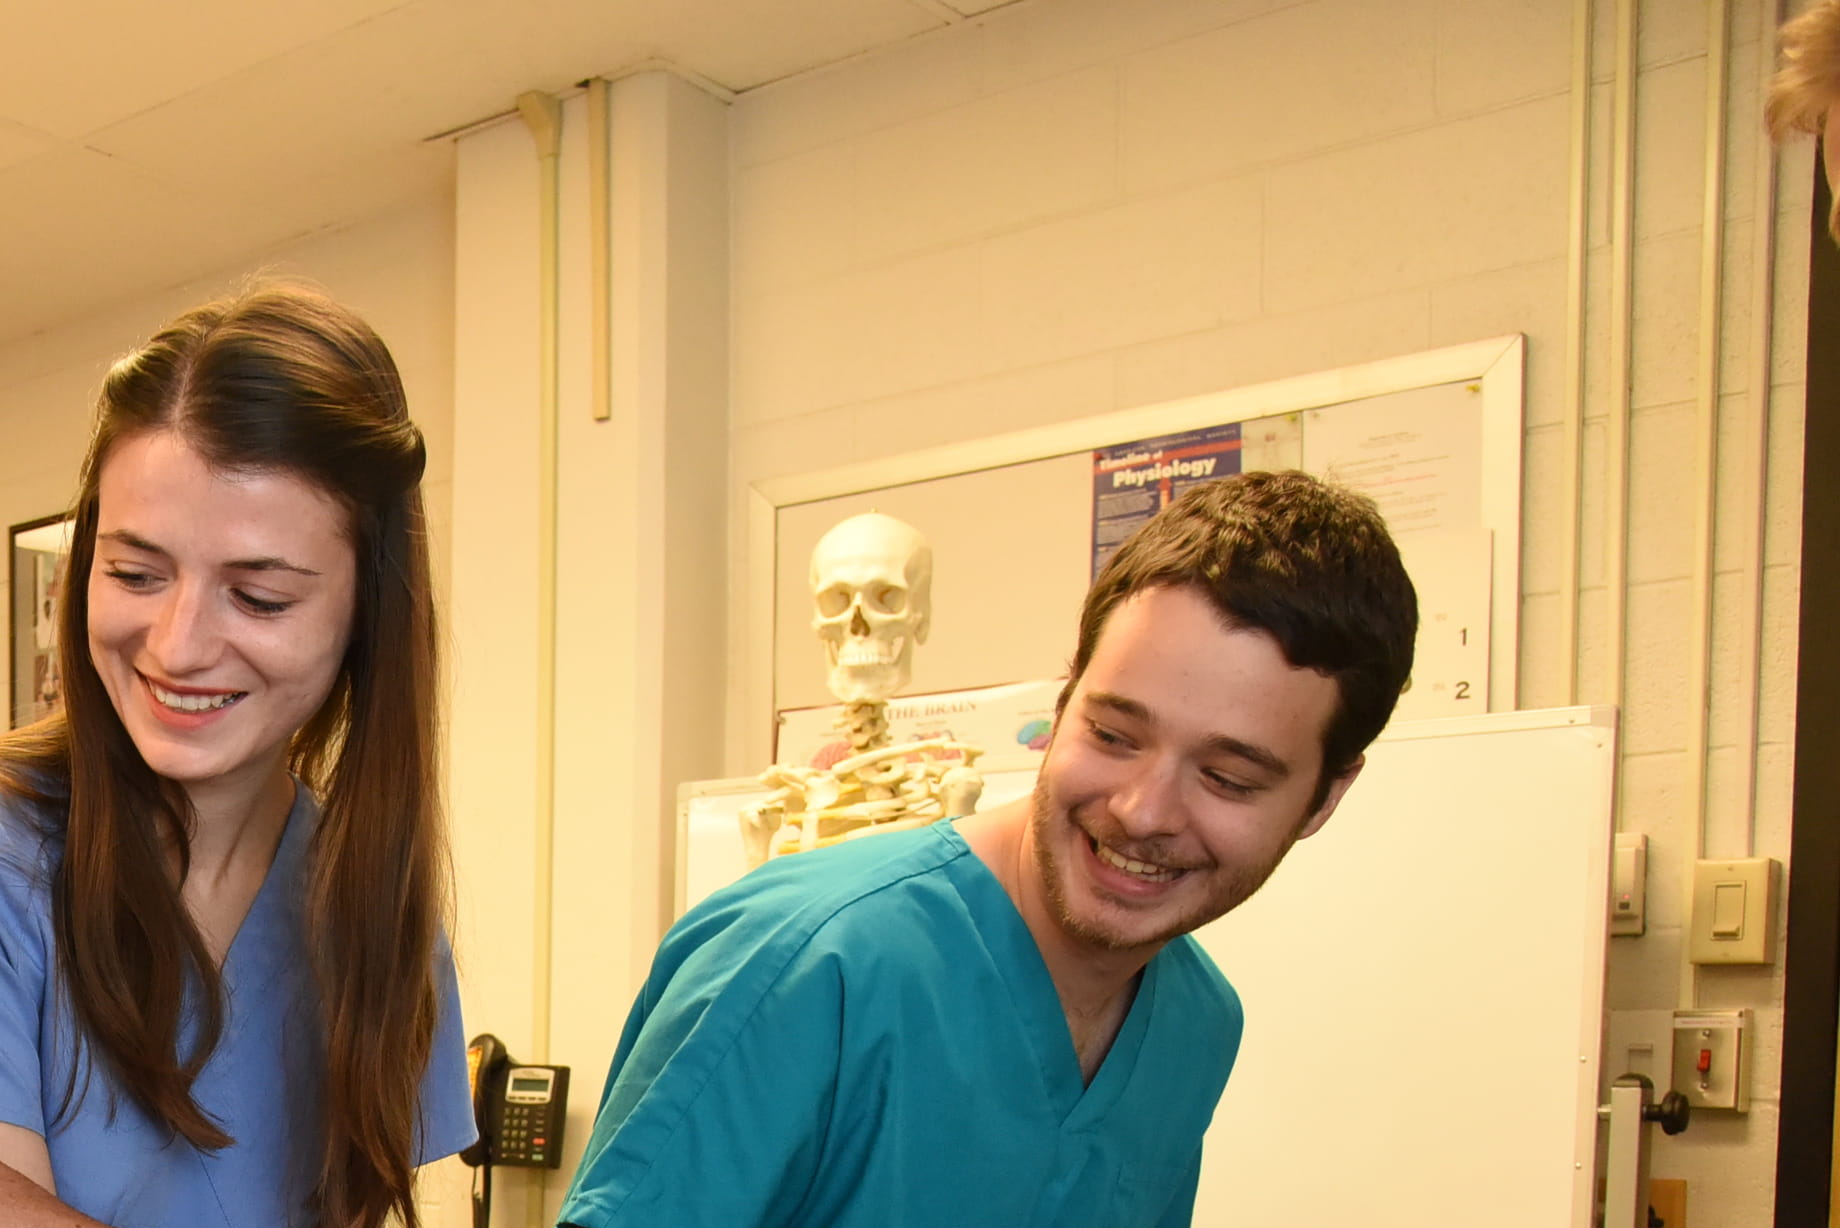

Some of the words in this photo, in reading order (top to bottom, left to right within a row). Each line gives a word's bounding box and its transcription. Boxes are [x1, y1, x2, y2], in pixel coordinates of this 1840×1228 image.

[1099, 453, 1151, 470] Timeline
[1152, 450, 1164, 460] of
[1112, 457, 1217, 488] Physiology
[1459, 628, 1467, 646] 1
[1455, 681, 1471, 700] 2
[888, 707, 919, 721] THE
[924, 701, 977, 717] BRAIN
